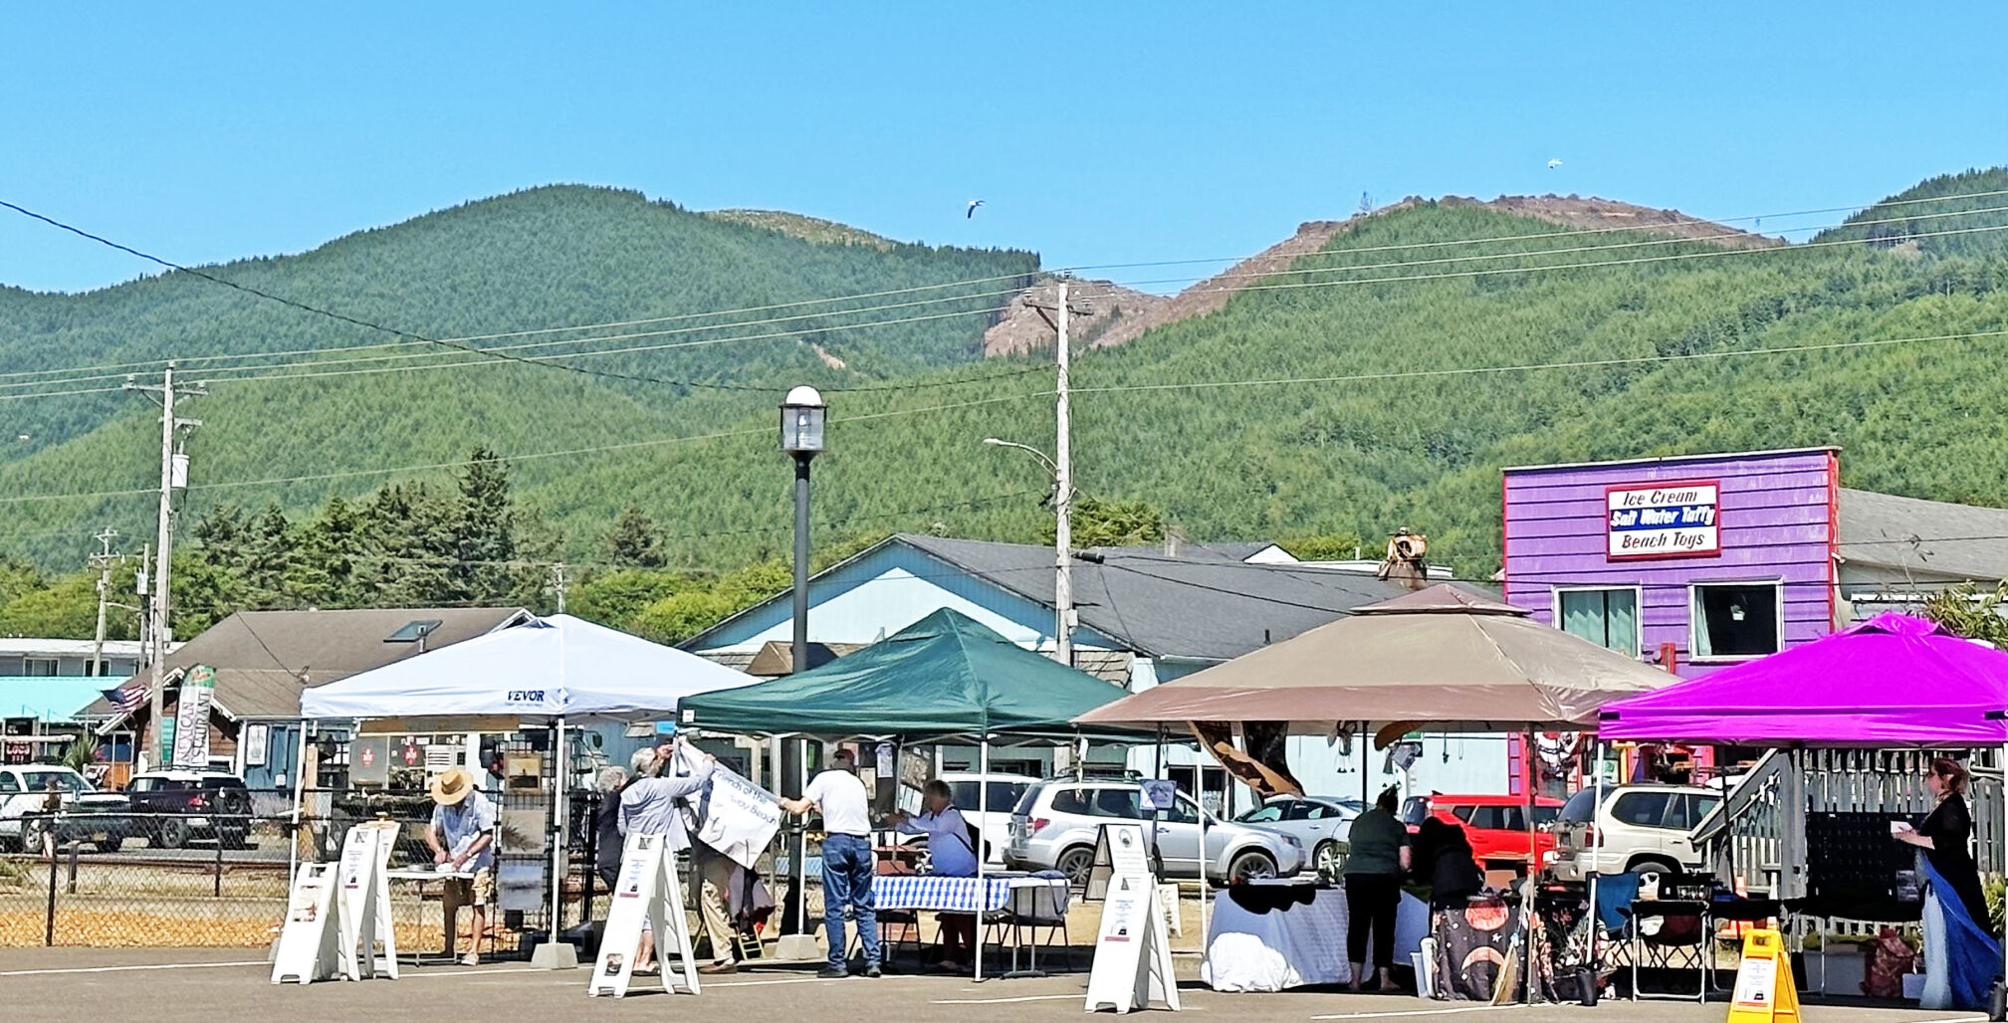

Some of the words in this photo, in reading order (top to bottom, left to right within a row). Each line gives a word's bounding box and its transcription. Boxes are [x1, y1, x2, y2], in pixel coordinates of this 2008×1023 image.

[1622, 492, 1645, 506] Ice
[1650, 490, 1698, 505] Cream
[1610, 510, 1638, 527] Salt
[1640, 508, 1680, 526] Water
[1681, 505, 1716, 526] Taffy
[1621, 533, 1668, 549] Beach
[1673, 531, 1705, 549] Toys
[507, 690, 545, 702] VEVOR
